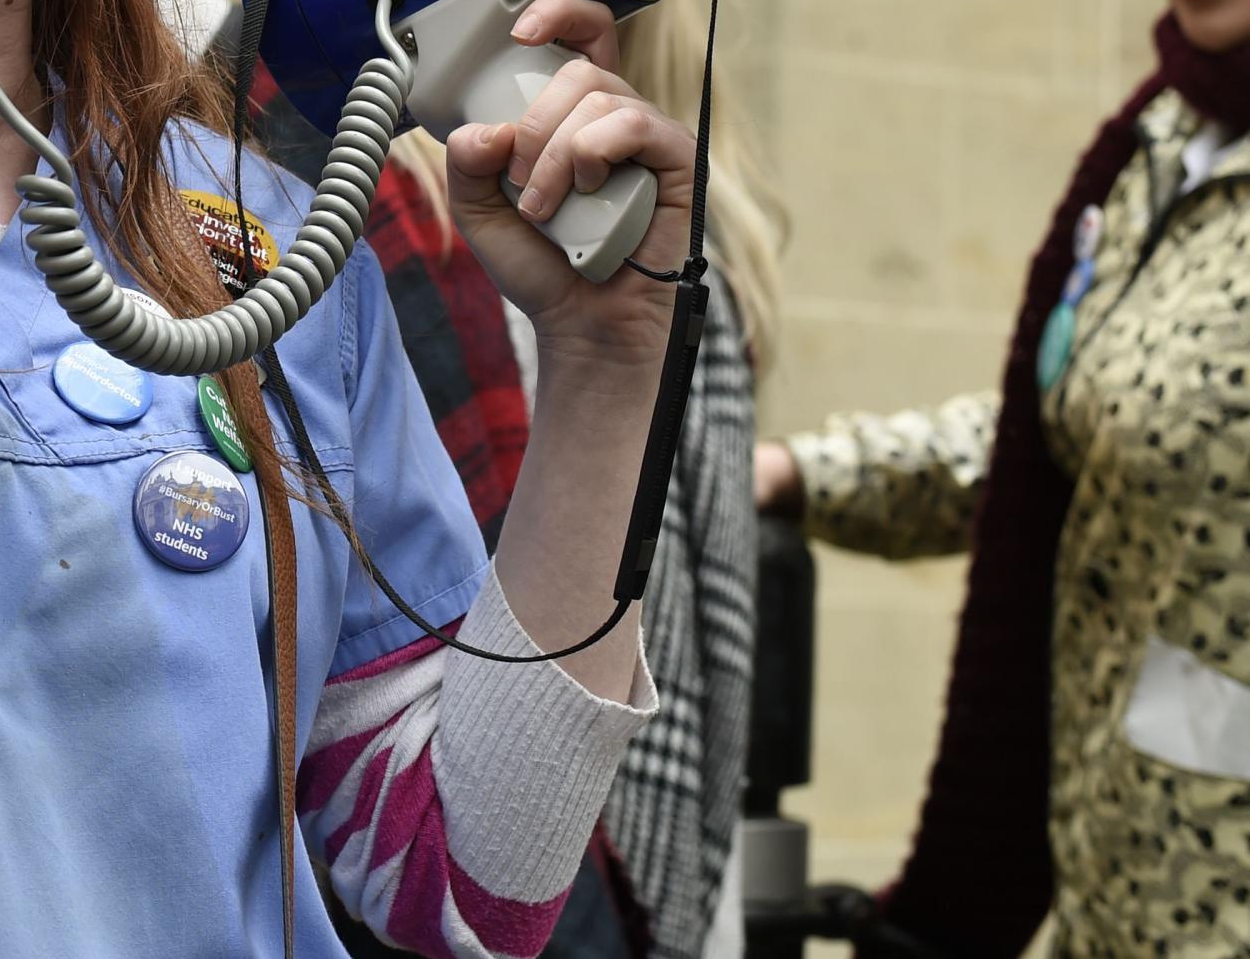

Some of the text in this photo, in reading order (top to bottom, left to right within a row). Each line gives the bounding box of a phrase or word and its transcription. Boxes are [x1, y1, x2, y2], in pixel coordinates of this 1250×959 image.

[158, 484, 236, 524] #BursaryOrBust
[172, 518, 205, 541] NHS
[154, 530, 210, 561] students
